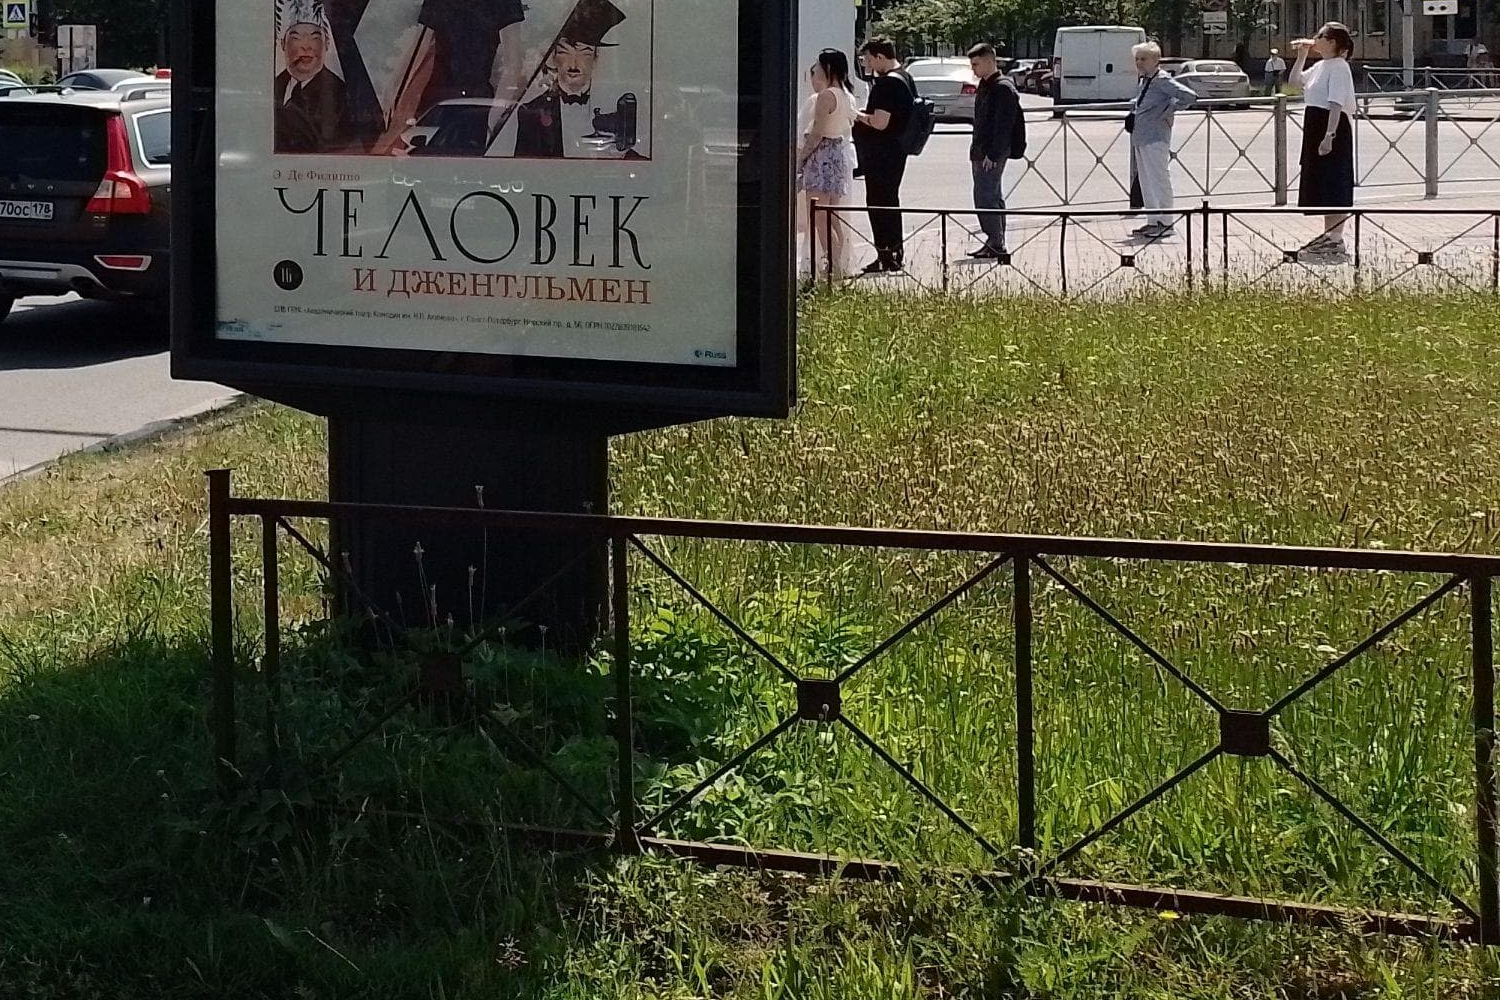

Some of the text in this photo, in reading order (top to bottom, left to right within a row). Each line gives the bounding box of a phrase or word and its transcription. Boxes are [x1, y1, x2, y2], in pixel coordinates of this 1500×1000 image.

[273, 186, 652, 270] ЧЕЛОВЕК
[353, 267, 653, 305] И ДЖЕНТЛЬМЕН
